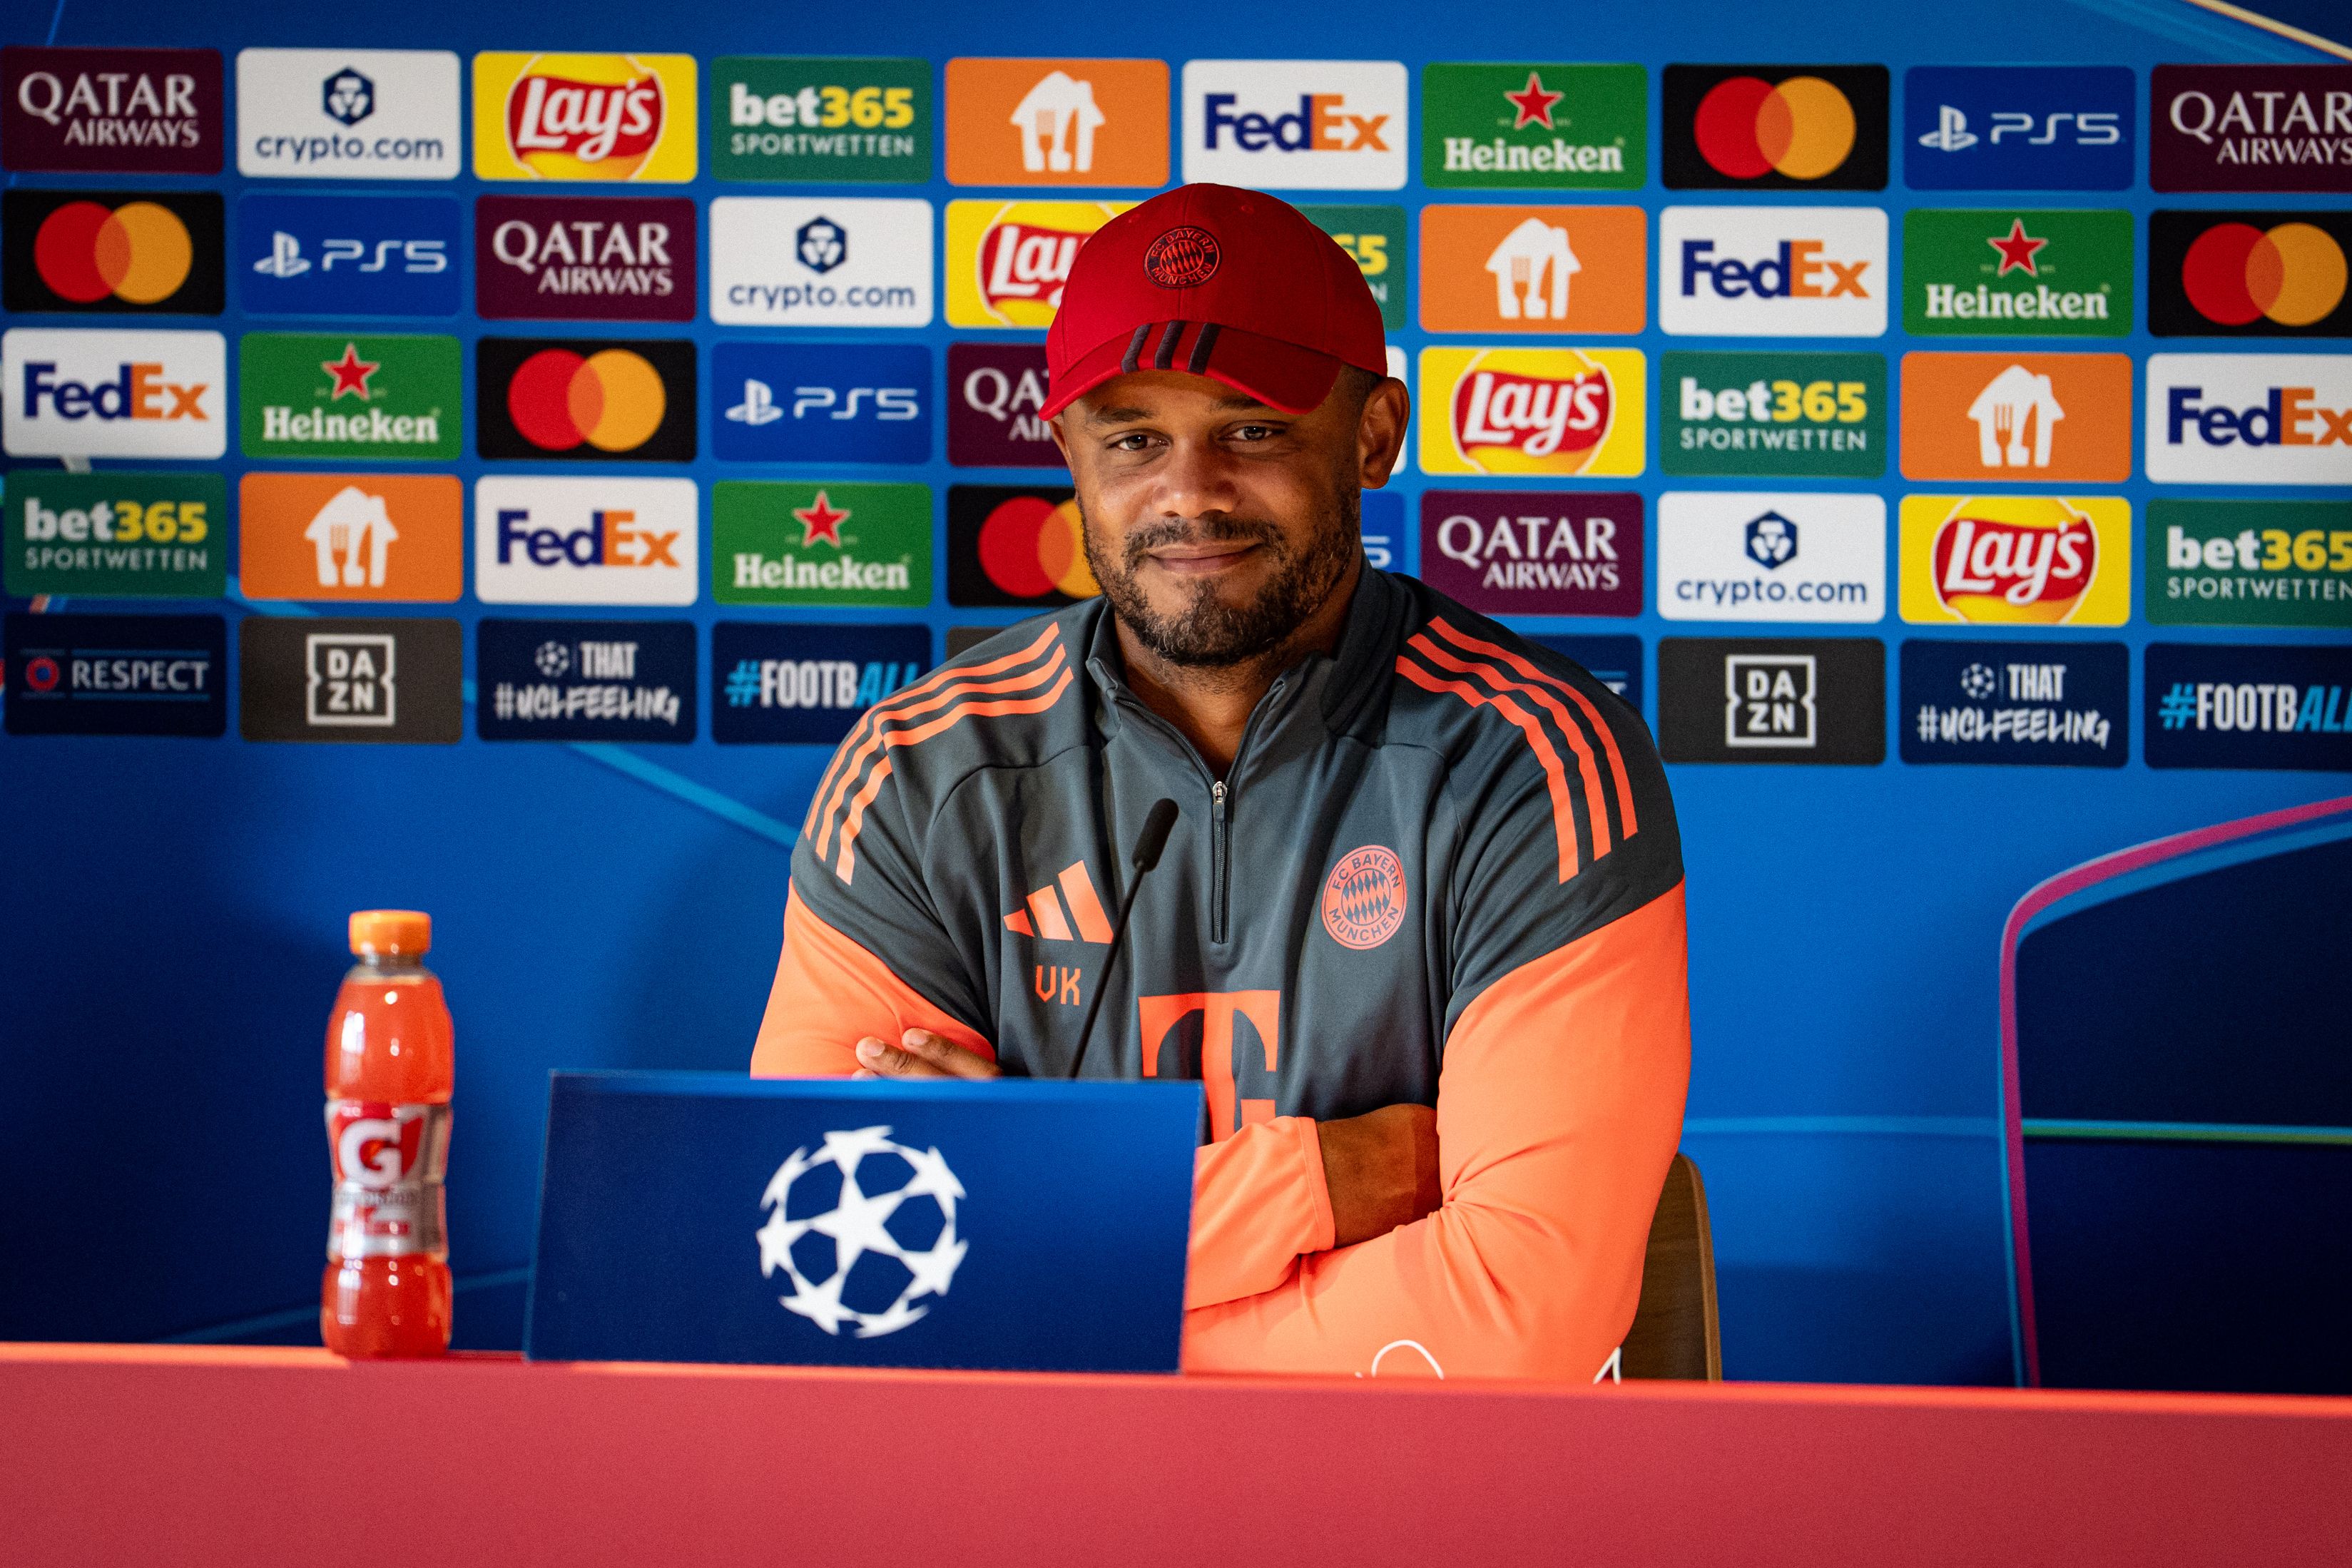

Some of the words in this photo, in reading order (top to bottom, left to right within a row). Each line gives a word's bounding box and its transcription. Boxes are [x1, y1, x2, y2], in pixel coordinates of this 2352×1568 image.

[18, 72, 197, 126] QATAR
[730, 83, 914, 128] bet365
[65, 118, 200, 146] AIRWAYS
[515, 76, 657, 162] Lay's
[1204, 93, 1388, 153] FedEx
[1990, 112, 2120, 145] PS5
[2169, 91, 2352, 146] QATAR
[254, 132, 444, 163] crypto.com
[731, 133, 915, 157] SPORTWETTEN
[1444, 137, 1624, 172] Heineken
[2216, 138, 2352, 164] AIRWAYS
[322, 239, 448, 273] PS5
[493, 220, 671, 276] QATAR
[1151, 243, 1165, 258] FC
[1165, 230, 1215, 253] BAYERN
[539, 266, 673, 295] AIRWAYS
[1681, 239, 1868, 300] FedEx
[727, 280, 916, 311] crypto.com
[1925, 284, 2109, 319] Heineken
[23, 362, 209, 422] FedEx
[793, 387, 919, 420] PS5
[1680, 377, 1867, 422] bet365
[263, 406, 439, 443] Heineken
[1462, 372, 1604, 458] Lay's
[2168, 387, 2352, 447] FedEx
[1681, 427, 1867, 452] SPORTWETTEN
[24, 498, 208, 543] bet365
[497, 509, 680, 569] FedEx
[26, 547, 208, 571] SPORTWETTEN
[1437, 515, 1617, 573] QATAR
[1943, 519, 2089, 606] Lay's
[2167, 526, 2352, 571] bet365
[734, 553, 909, 590] Heineken
[1483, 561, 1620, 590] AIRWAYS
[1676, 577, 1868, 606] crypto.com
[71, 660, 209, 691] RESPECT
[581, 641, 638, 678] THAT
[2007, 663, 2066, 701] THAT
[495, 683, 681, 724] #UCLFEELING
[1918, 706, 2110, 748] #UCLFEELING
[1332, 868, 1349, 890] FC
[1351, 854, 1400, 888] BAYERN
[1035, 964, 1081, 1006] VK
[339, 1118, 403, 1190] G
